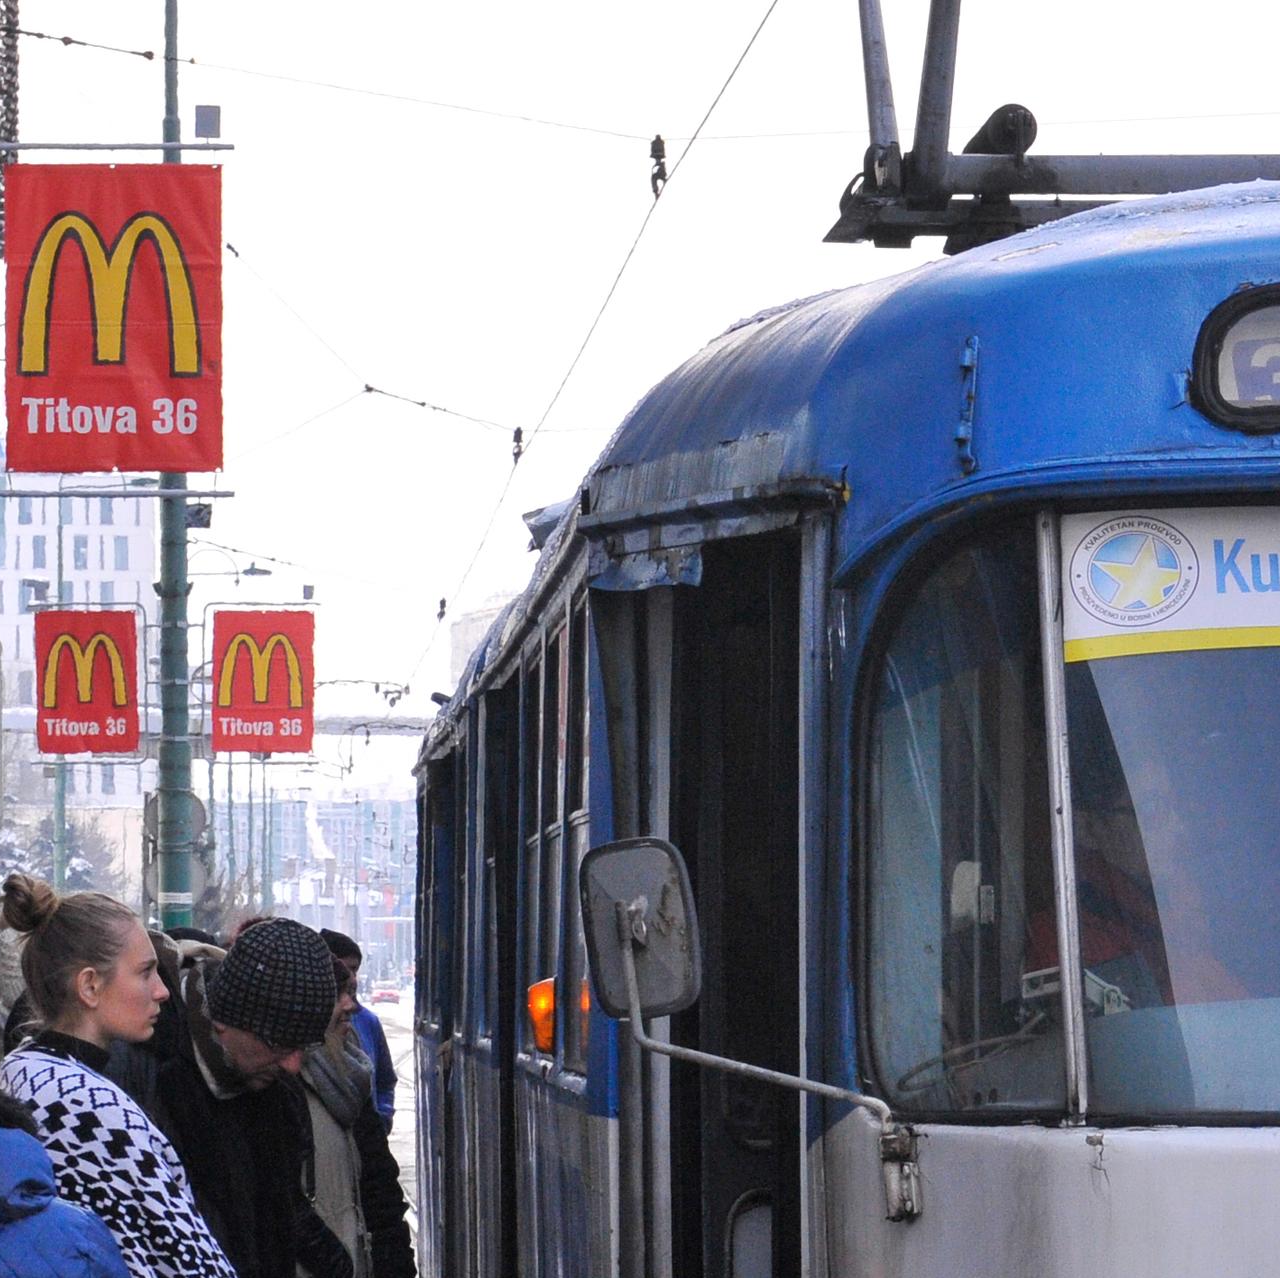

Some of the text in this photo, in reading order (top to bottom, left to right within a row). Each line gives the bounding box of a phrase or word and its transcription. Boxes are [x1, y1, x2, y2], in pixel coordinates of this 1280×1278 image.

[21, 397, 198, 435] Titova 36
[1083, 520, 1182, 552] KVALITETAN PROIZVOD
[43, 717, 127, 736] Titova 36
[219, 717, 302, 736] Titova 36
